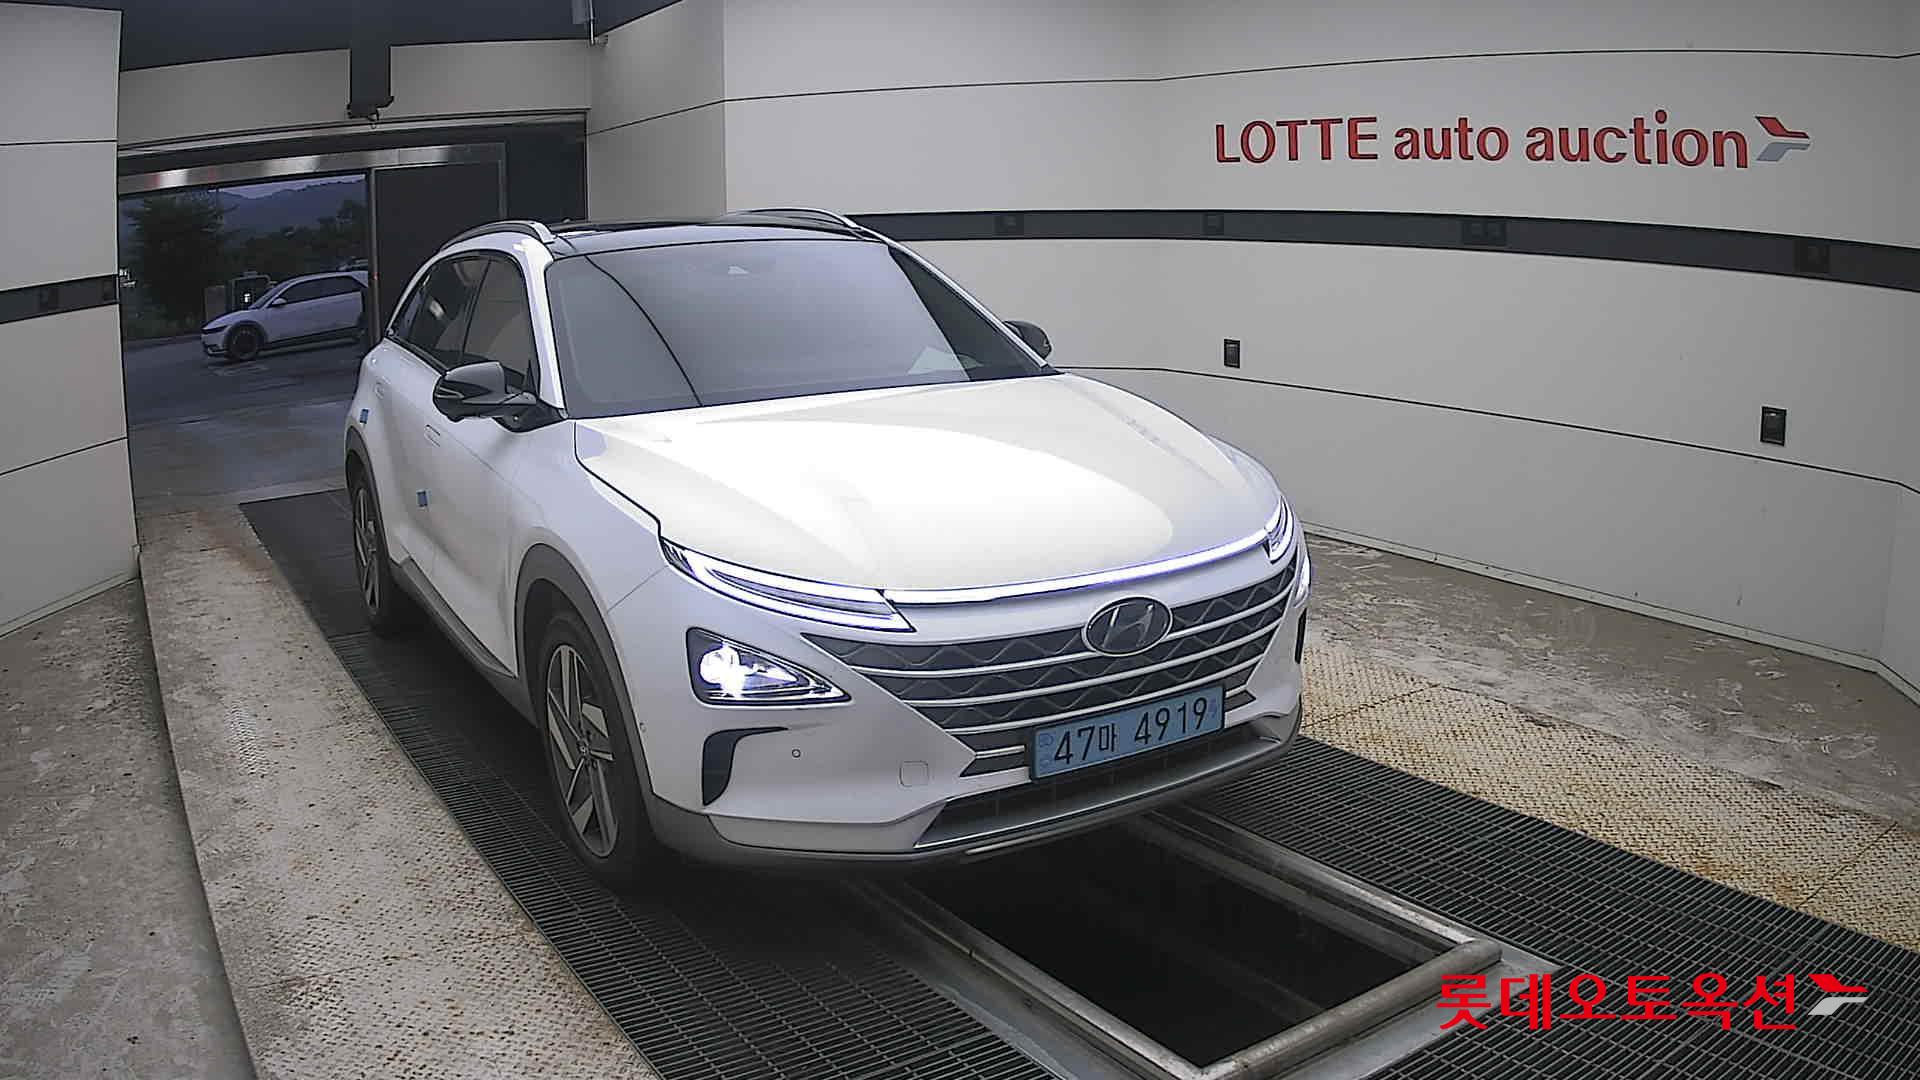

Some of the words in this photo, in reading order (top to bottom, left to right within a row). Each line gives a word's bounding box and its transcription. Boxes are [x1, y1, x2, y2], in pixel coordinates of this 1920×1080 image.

[1215, 116, 1378, 163] LOTTE
[1394, 117, 1508, 161] auto
[1525, 110, 1748, 168] auction
[1054, 723, 1118, 764] 47마
[1134, 697, 1208, 745] 4919
